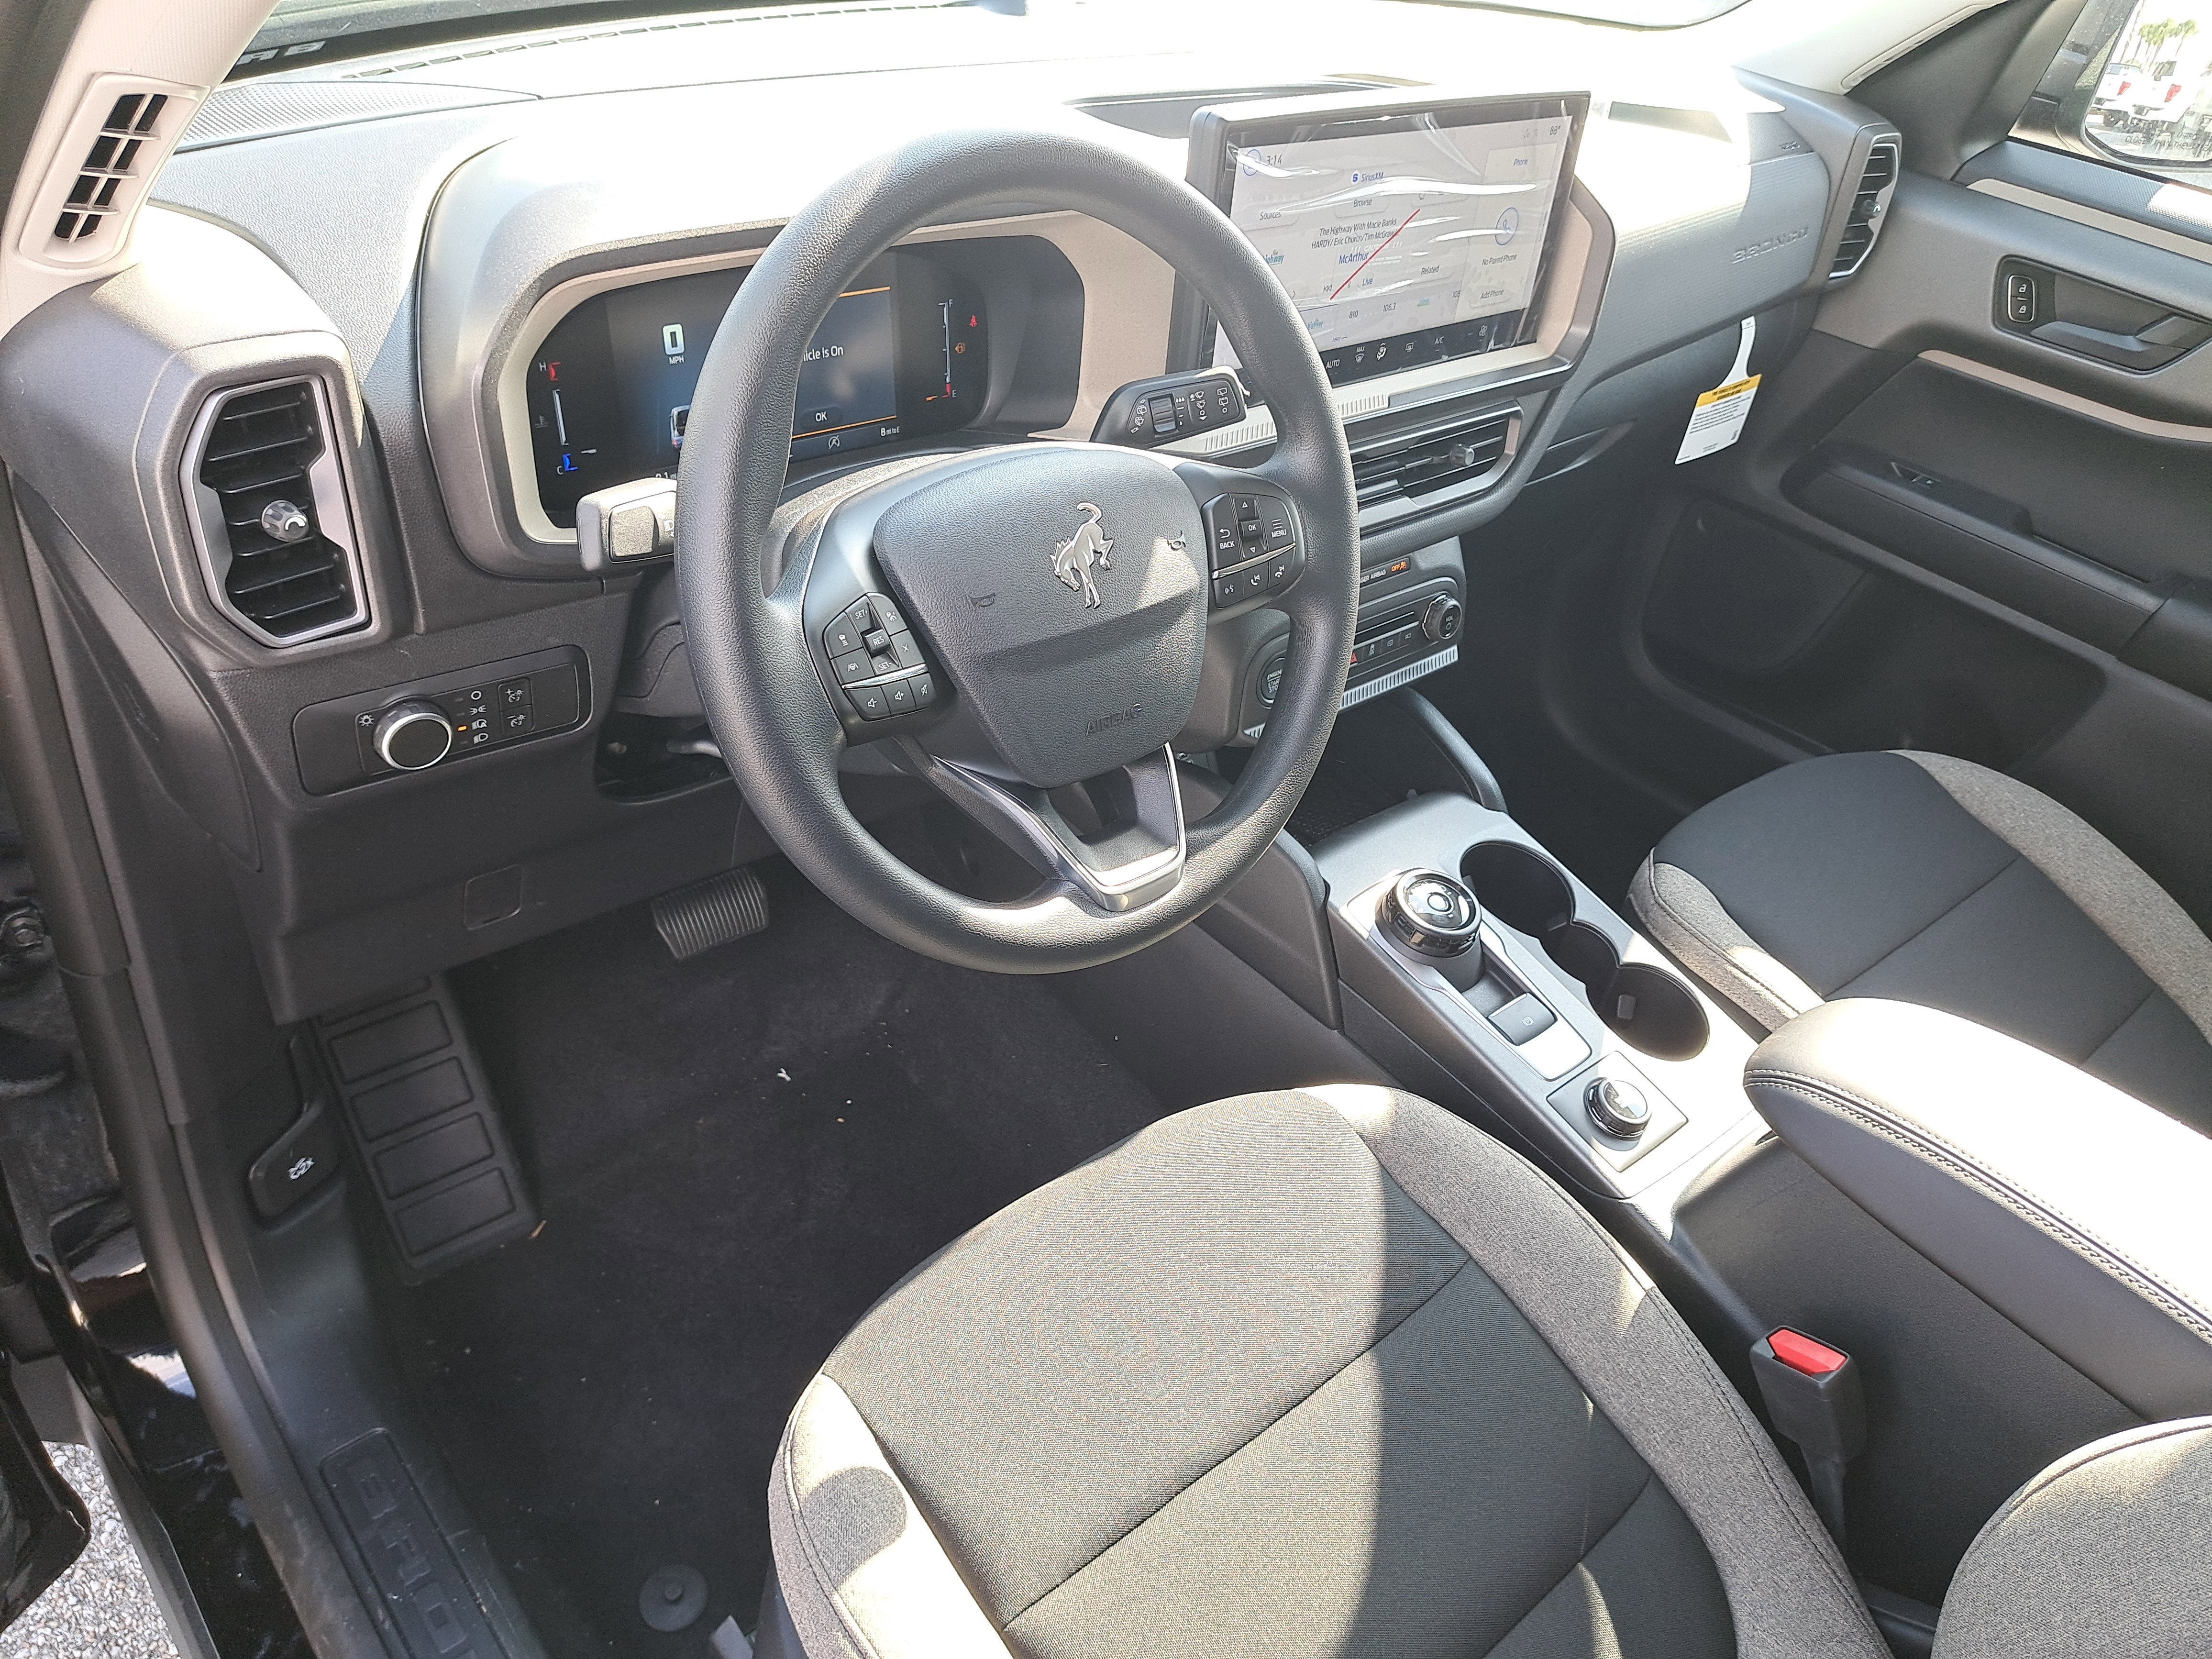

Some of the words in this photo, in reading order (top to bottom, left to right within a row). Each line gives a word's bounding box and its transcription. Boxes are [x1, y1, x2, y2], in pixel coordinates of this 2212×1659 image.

[1267, 154, 1283, 166] 3:14
[1513, 158, 1528, 166] Phone
[1361, 171, 1384, 182] SiriusXM
[1353, 199, 1372, 208] Browse
[1260, 211, 1282, 221] Sources
[1320, 228, 1329, 237] The
[1330, 224, 1352, 235] Highway
[1354, 222, 1366, 232] With
[1367, 221, 1381, 231] Macie
[1382, 218, 1397, 228] Banks
[1334, 236, 1344, 246] Eric
[1262, 253, 1284, 265] ighway
[1338, 252, 1369, 265] McArthur
[1489, 255, 1503, 265] Paired
[1421, 265, 1439, 275] Related
[1362, 277, 1373, 286] Live
[1490, 289, 1504, 298] Phone
[949, 299, 953, 308] F
[1383, 302, 1396, 312] 106.3
[1349, 310, 1359, 319] 810
[663, 324, 685, 355] 0
[1435, 336, 1444, 345] A/C
[822, 346, 830, 358] Is
[830, 345, 844, 357] On
[669, 355, 685, 365] MPH
[1326, 358, 1340, 370] AUTO
[539, 362, 547, 372] H
[952, 389, 957, 398] E
[815, 411, 828, 422] OK
[557, 465, 564, 475] C
[1271, 528, 1287, 539] MENU
[1219, 540, 1236, 550] BACK
[1360, 575, 1370, 583] GER
[1370, 568, 1386, 580] AIRBAG
[1391, 564, 1401, 572] OFF
[872, 636, 885, 646] RES
[1267, 669, 1283, 680] ENGIN
